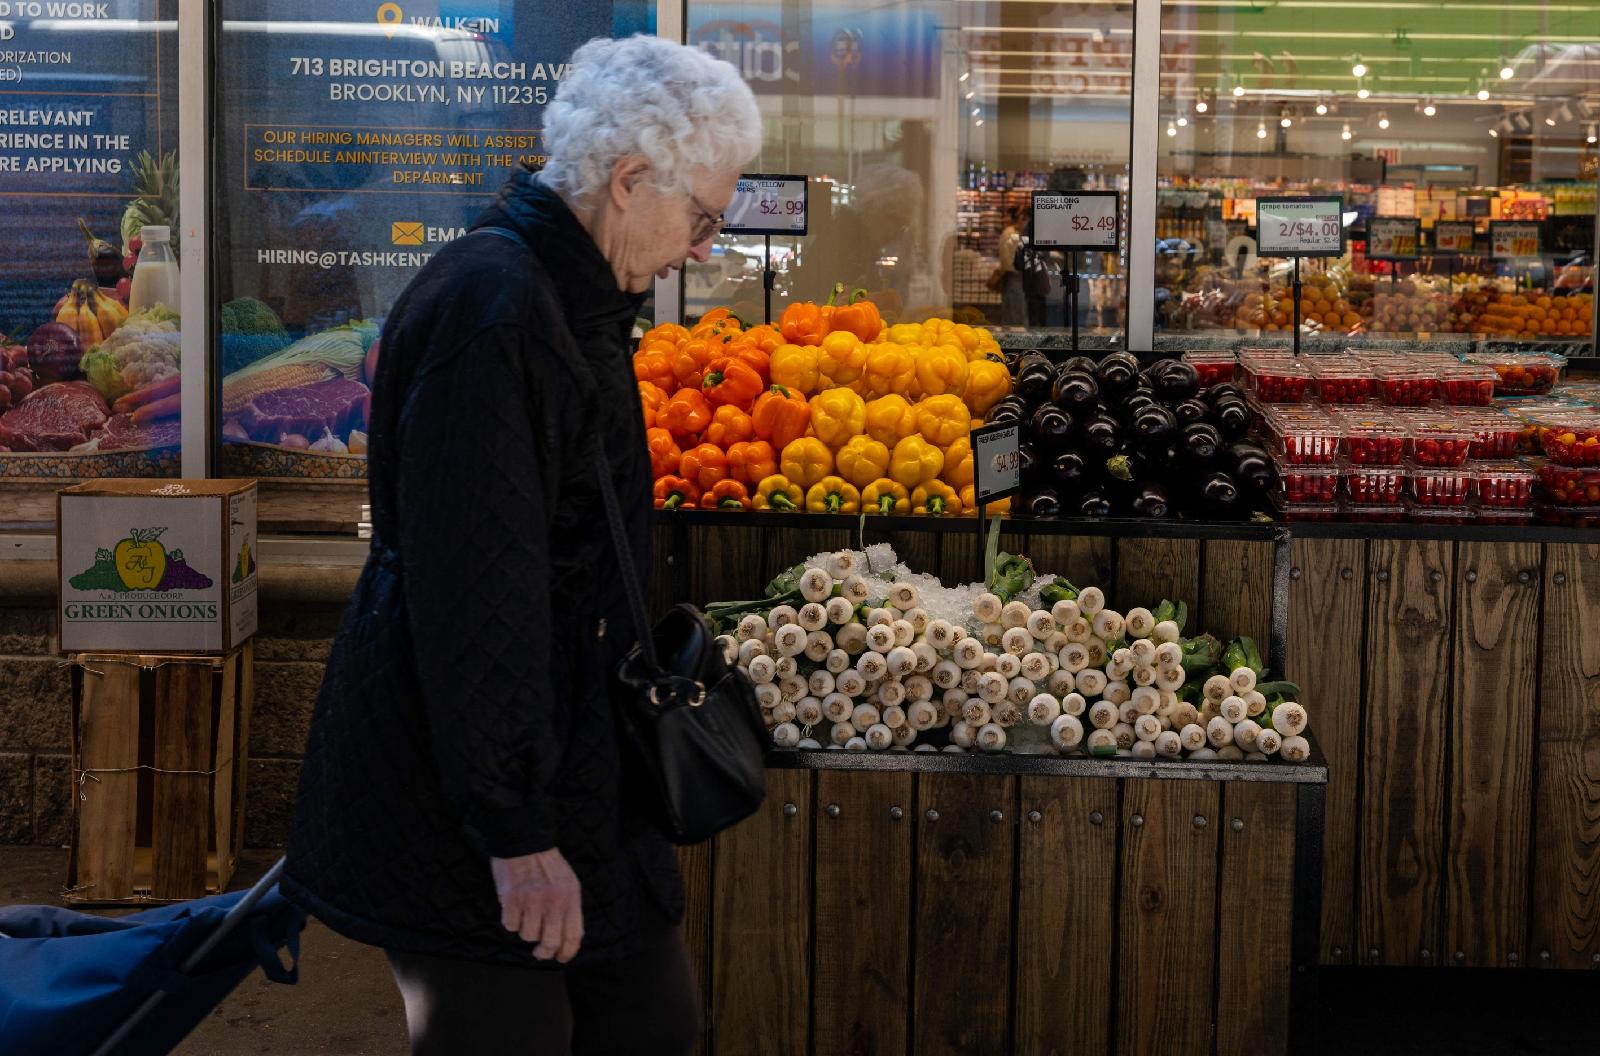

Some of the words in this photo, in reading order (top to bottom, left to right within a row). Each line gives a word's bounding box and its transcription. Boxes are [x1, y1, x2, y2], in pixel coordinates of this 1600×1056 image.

[15, 2, 42, 17] TO
[46, 2, 109, 18] WORK
[410, 16, 499, 33] WALK-IN
[290, 57, 324, 76] 713
[329, 58, 445, 79] BRIGHTON
[450, 61, 526, 80] BEACH
[329, 83, 450, 105] BROOKLYN,
[457, 86, 486, 104] NY
[492, 86, 548, 105] 11235
[68, 134, 88, 150] IN
[92, 134, 130, 150] THE
[263, 130, 297, 144] OUR
[300, 131, 353, 145] HIRING
[356, 132, 443, 147] MANAGERS
[446, 134, 480, 148] WILL
[483, 135, 537, 149] ASSIST
[24, 156, 122, 174] APPLYING
[253, 149, 331, 163] SCHEDULE
[334, 151, 437, 166] ANINTERVIEW
[440, 153, 481, 167] WITH
[484, 153, 512, 167] THE
[760, 199, 804, 215] $2.99
[1071, 214, 1115, 231] $2.49
[1279, 222, 1339, 237] 2/$4.00
[119, 592, 160, 600] PRODUCE
[64, 604, 135, 619] GREEN
[138, 604, 218, 619] ONIONS
